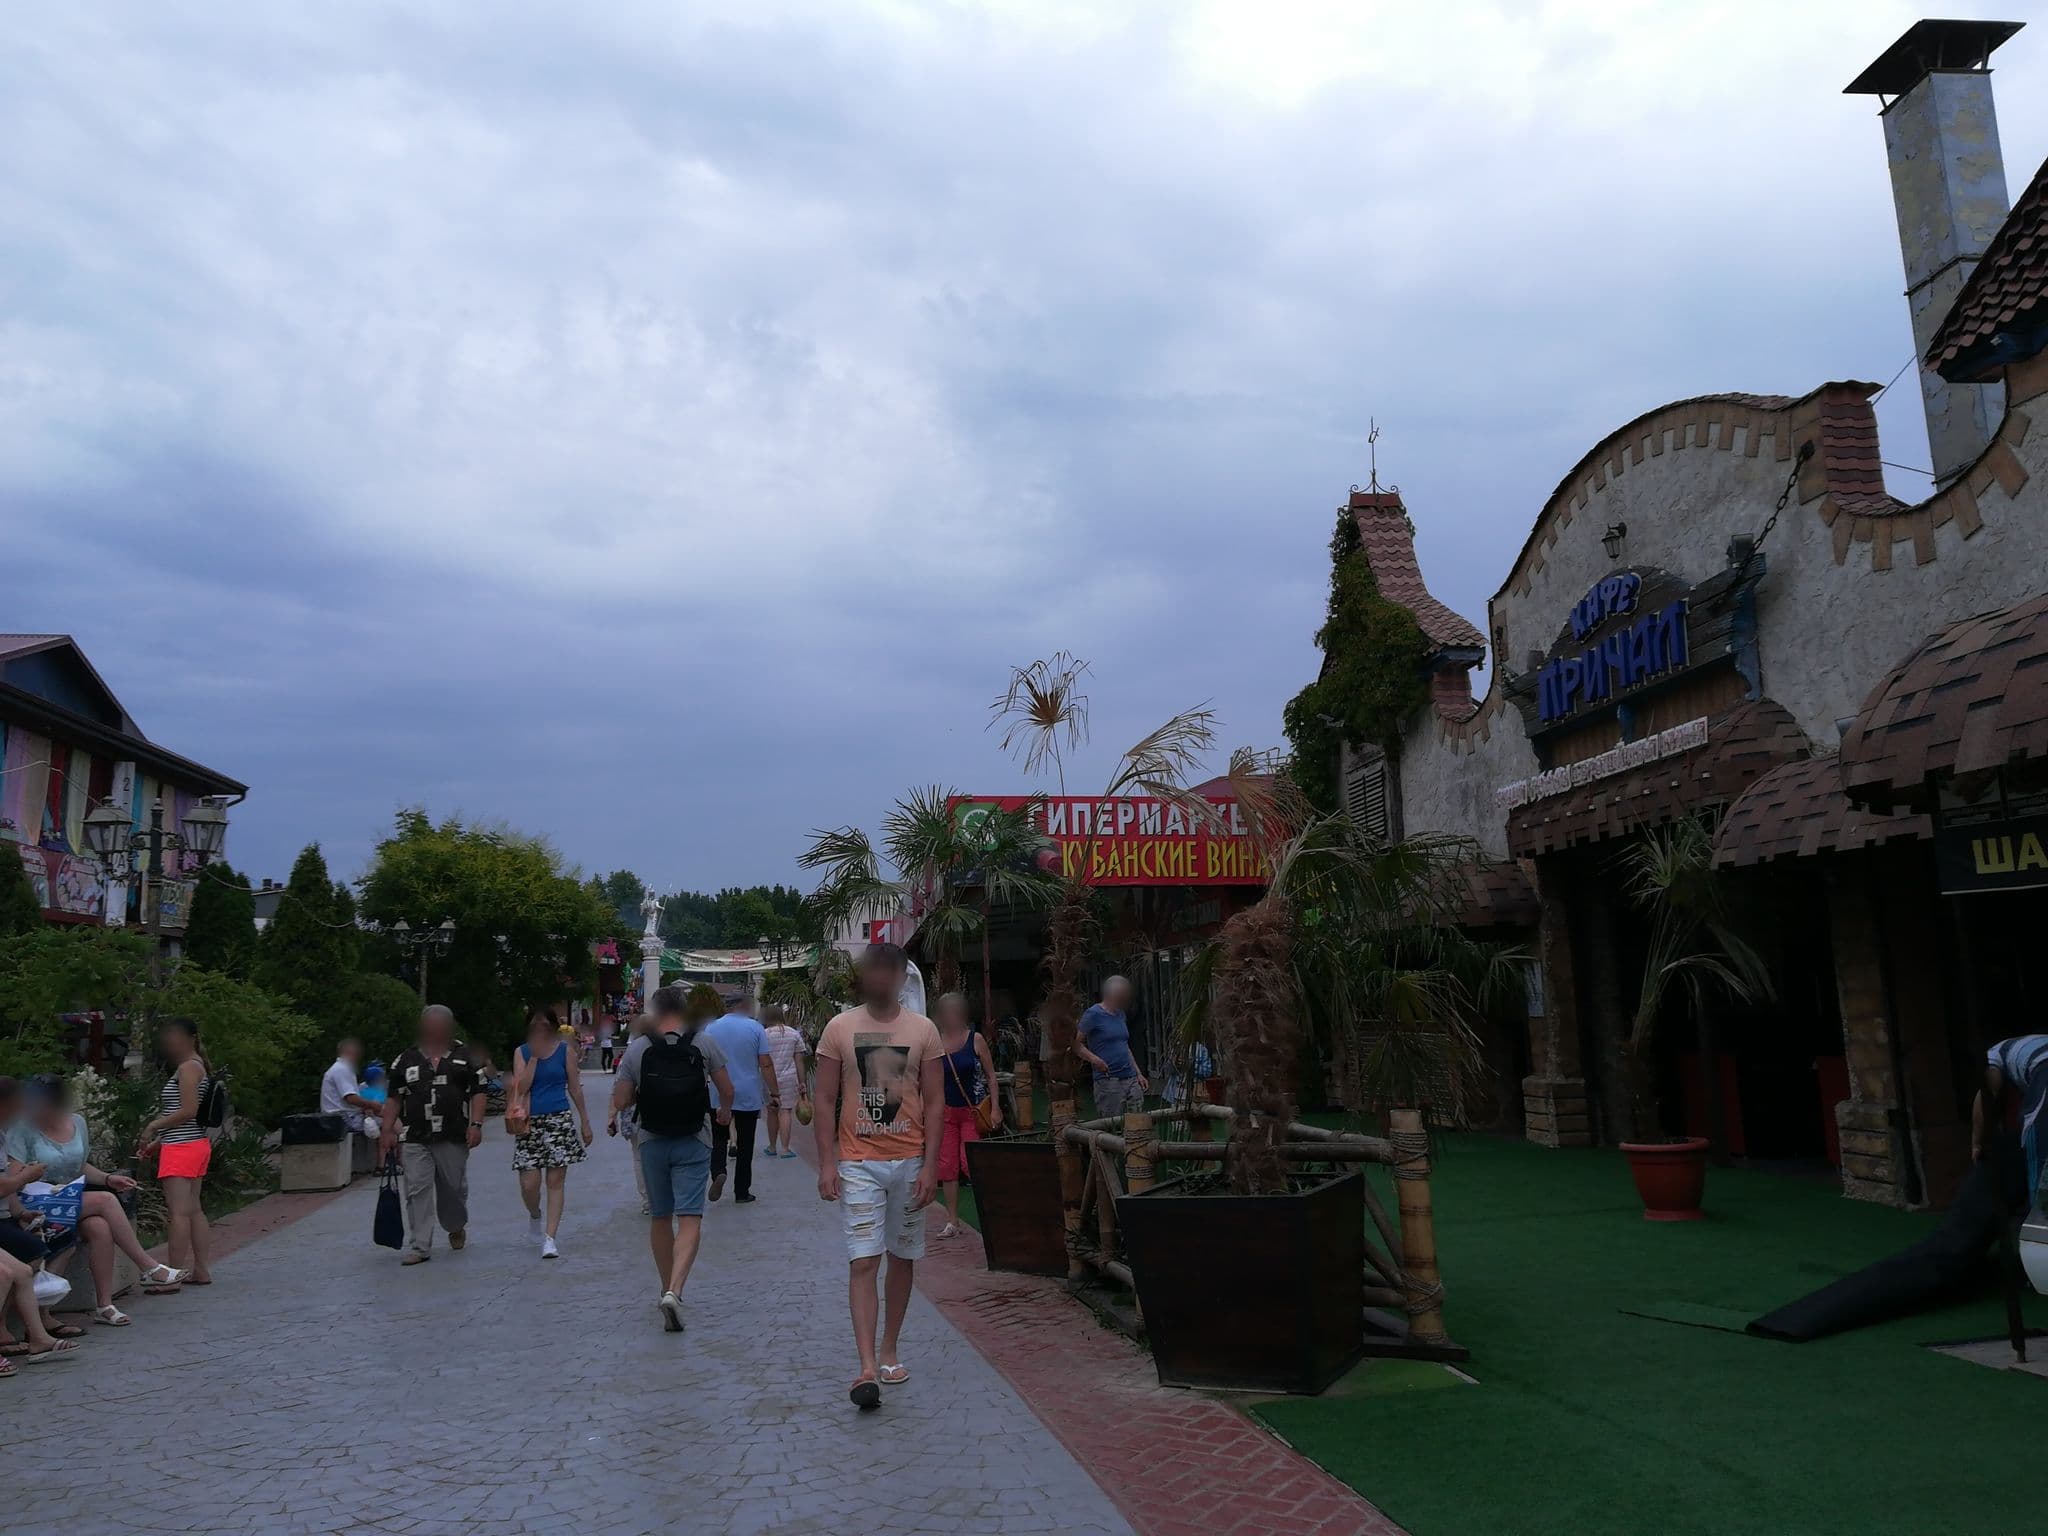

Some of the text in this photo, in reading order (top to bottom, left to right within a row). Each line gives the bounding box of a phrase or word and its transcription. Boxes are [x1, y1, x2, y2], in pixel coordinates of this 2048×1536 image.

[1569, 572, 1642, 643] КАФЕ
[1537, 597, 1690, 725] ПРИЧАЛ
[1026, 802, 1270, 836] ГИПЕРМАРКЕ
[856, 1107, 883, 1121] OLD
[857, 1093, 886, 1107] THIS
